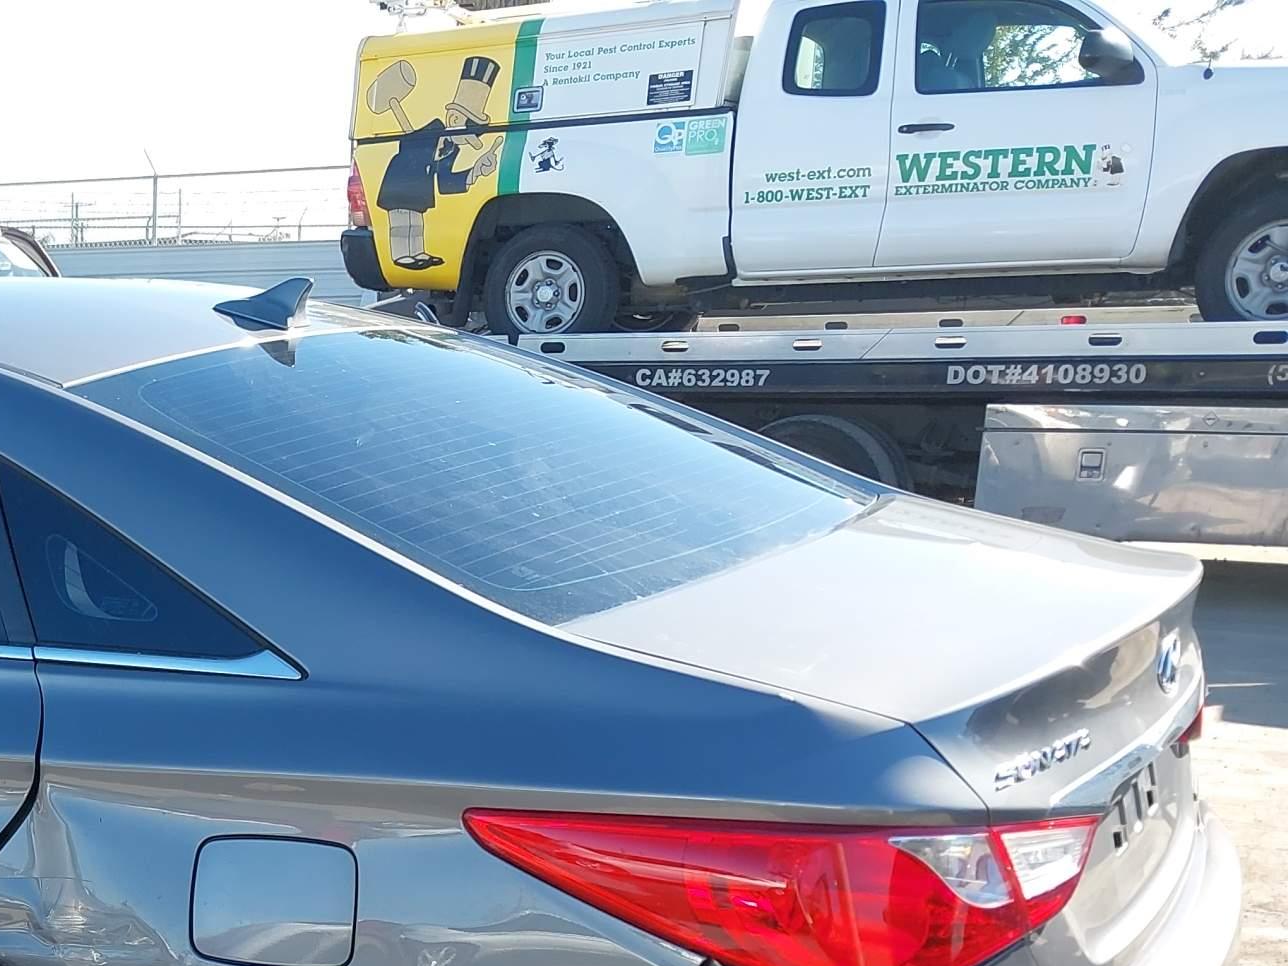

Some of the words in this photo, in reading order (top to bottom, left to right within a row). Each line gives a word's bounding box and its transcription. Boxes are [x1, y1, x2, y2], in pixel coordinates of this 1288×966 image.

[545, 53, 565, 61] Your
[567, 48, 594, 58] Local
[597, 46, 617, 55] Pest
[620, 41, 655, 52] Control
[658, 37, 695, 49] Experts
[543, 64, 569, 73] Since
[572, 61, 592, 70] 1921
[552, 74, 590, 86] Rentokil
[593, 70, 640, 82] Company
[689, 120, 725, 130] GREEN
[896, 144, 1097, 183] WESTERN
[765, 166, 872, 183] west-ext.com
[744, 185, 870, 204] 1-800-WEST-EXT
[894, 180, 1009, 196] EXTERMINATOR
[1013, 177, 1092, 190] COMPANY
[635, 369, 771, 387] CA#632987
[947, 364, 1147, 385] DOT#4108930
[994, 728, 1091, 792] SONATA
